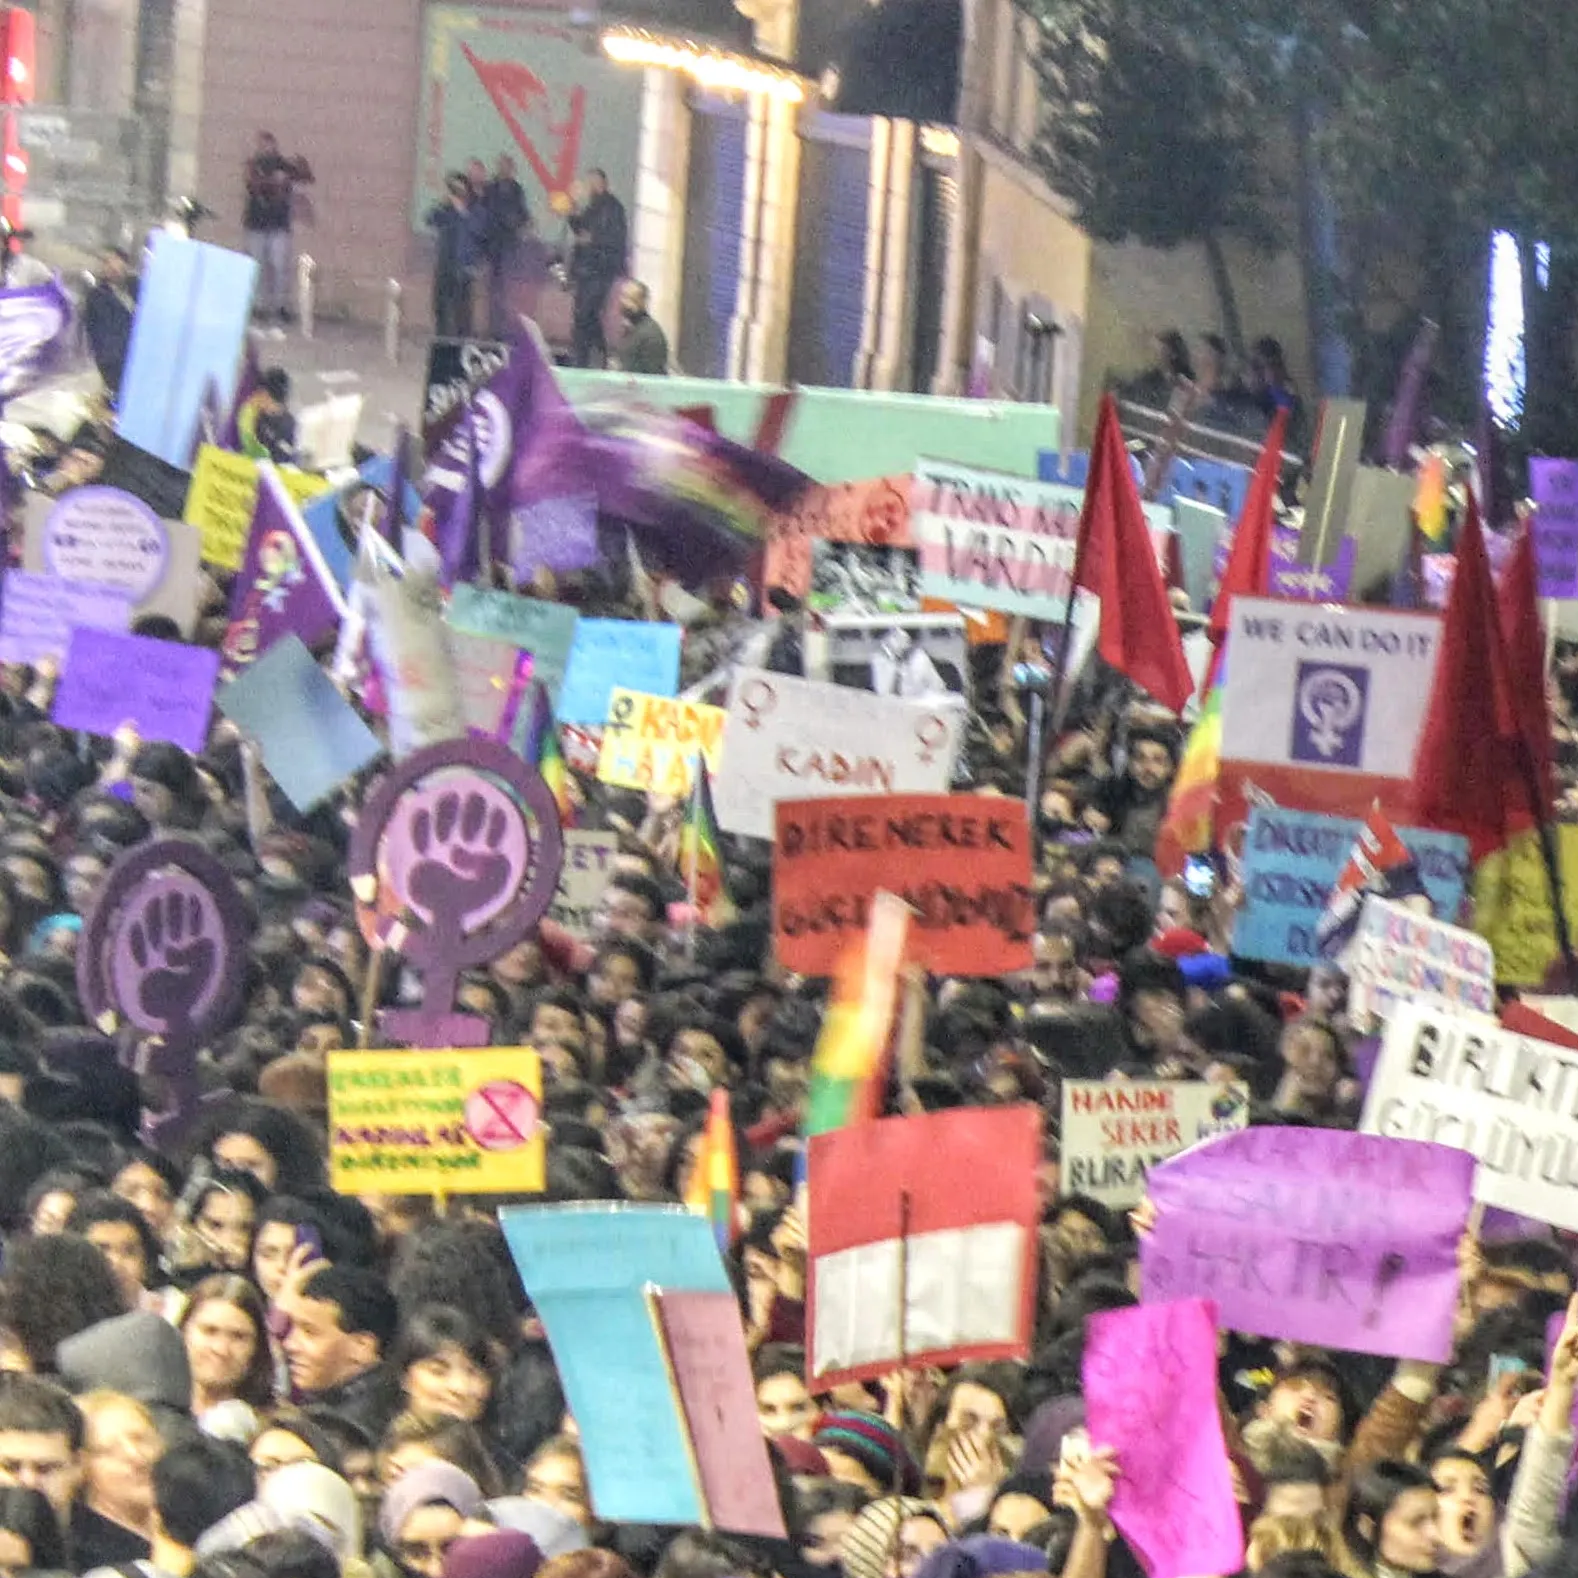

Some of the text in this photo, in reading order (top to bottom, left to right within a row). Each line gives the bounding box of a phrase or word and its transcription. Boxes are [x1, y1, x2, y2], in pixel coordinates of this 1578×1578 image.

[1242, 614, 1432, 660] WE CAN DO IT
